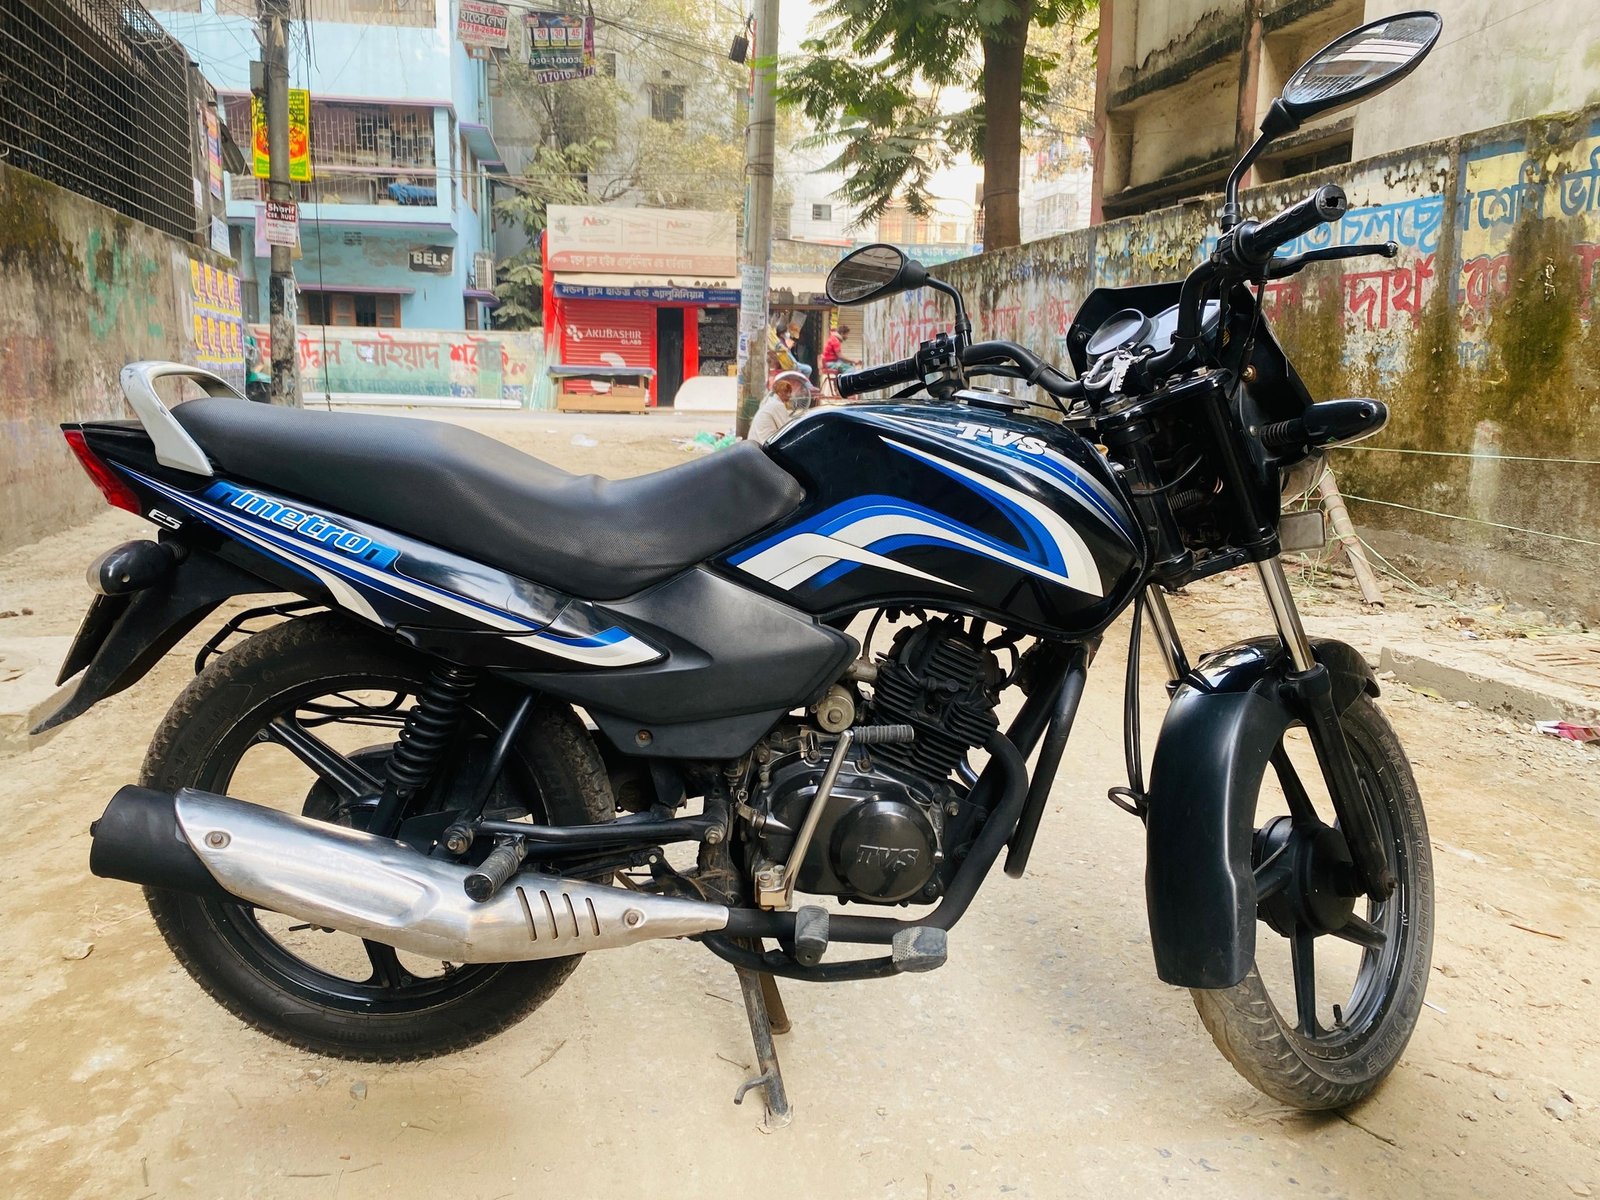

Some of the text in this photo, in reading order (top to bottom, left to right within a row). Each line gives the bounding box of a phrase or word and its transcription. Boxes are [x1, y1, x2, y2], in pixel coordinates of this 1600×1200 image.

[267, 202, 295, 214] Sharif
[1341, 195, 1445, 254] চলছে
[955, 421, 1047, 456] TVS
[148, 508, 183, 530] ES
[231, 490, 373, 554] metro
[857, 844, 920, 872] TVS
